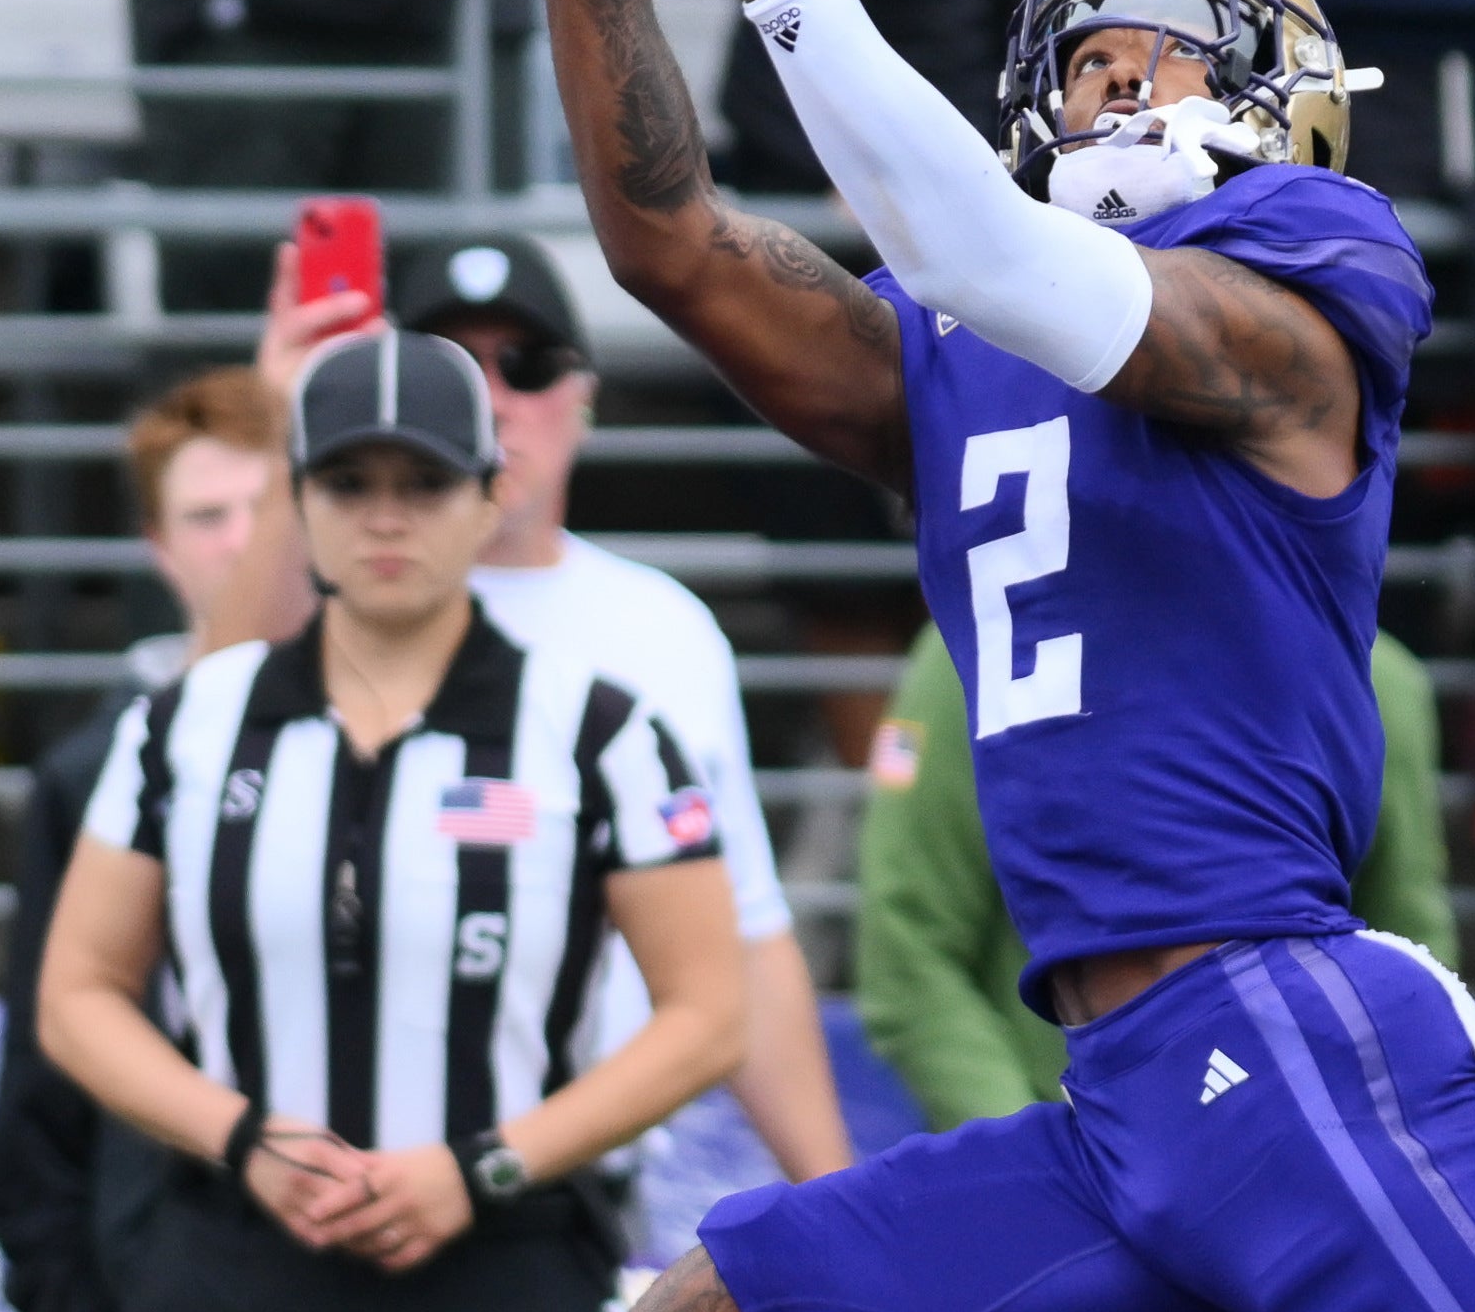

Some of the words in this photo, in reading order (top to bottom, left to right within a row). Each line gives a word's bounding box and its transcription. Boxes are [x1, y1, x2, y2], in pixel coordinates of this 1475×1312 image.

[959, 414, 1084, 740] 2
[222, 768, 266, 819] S
[454, 910, 508, 980] S
